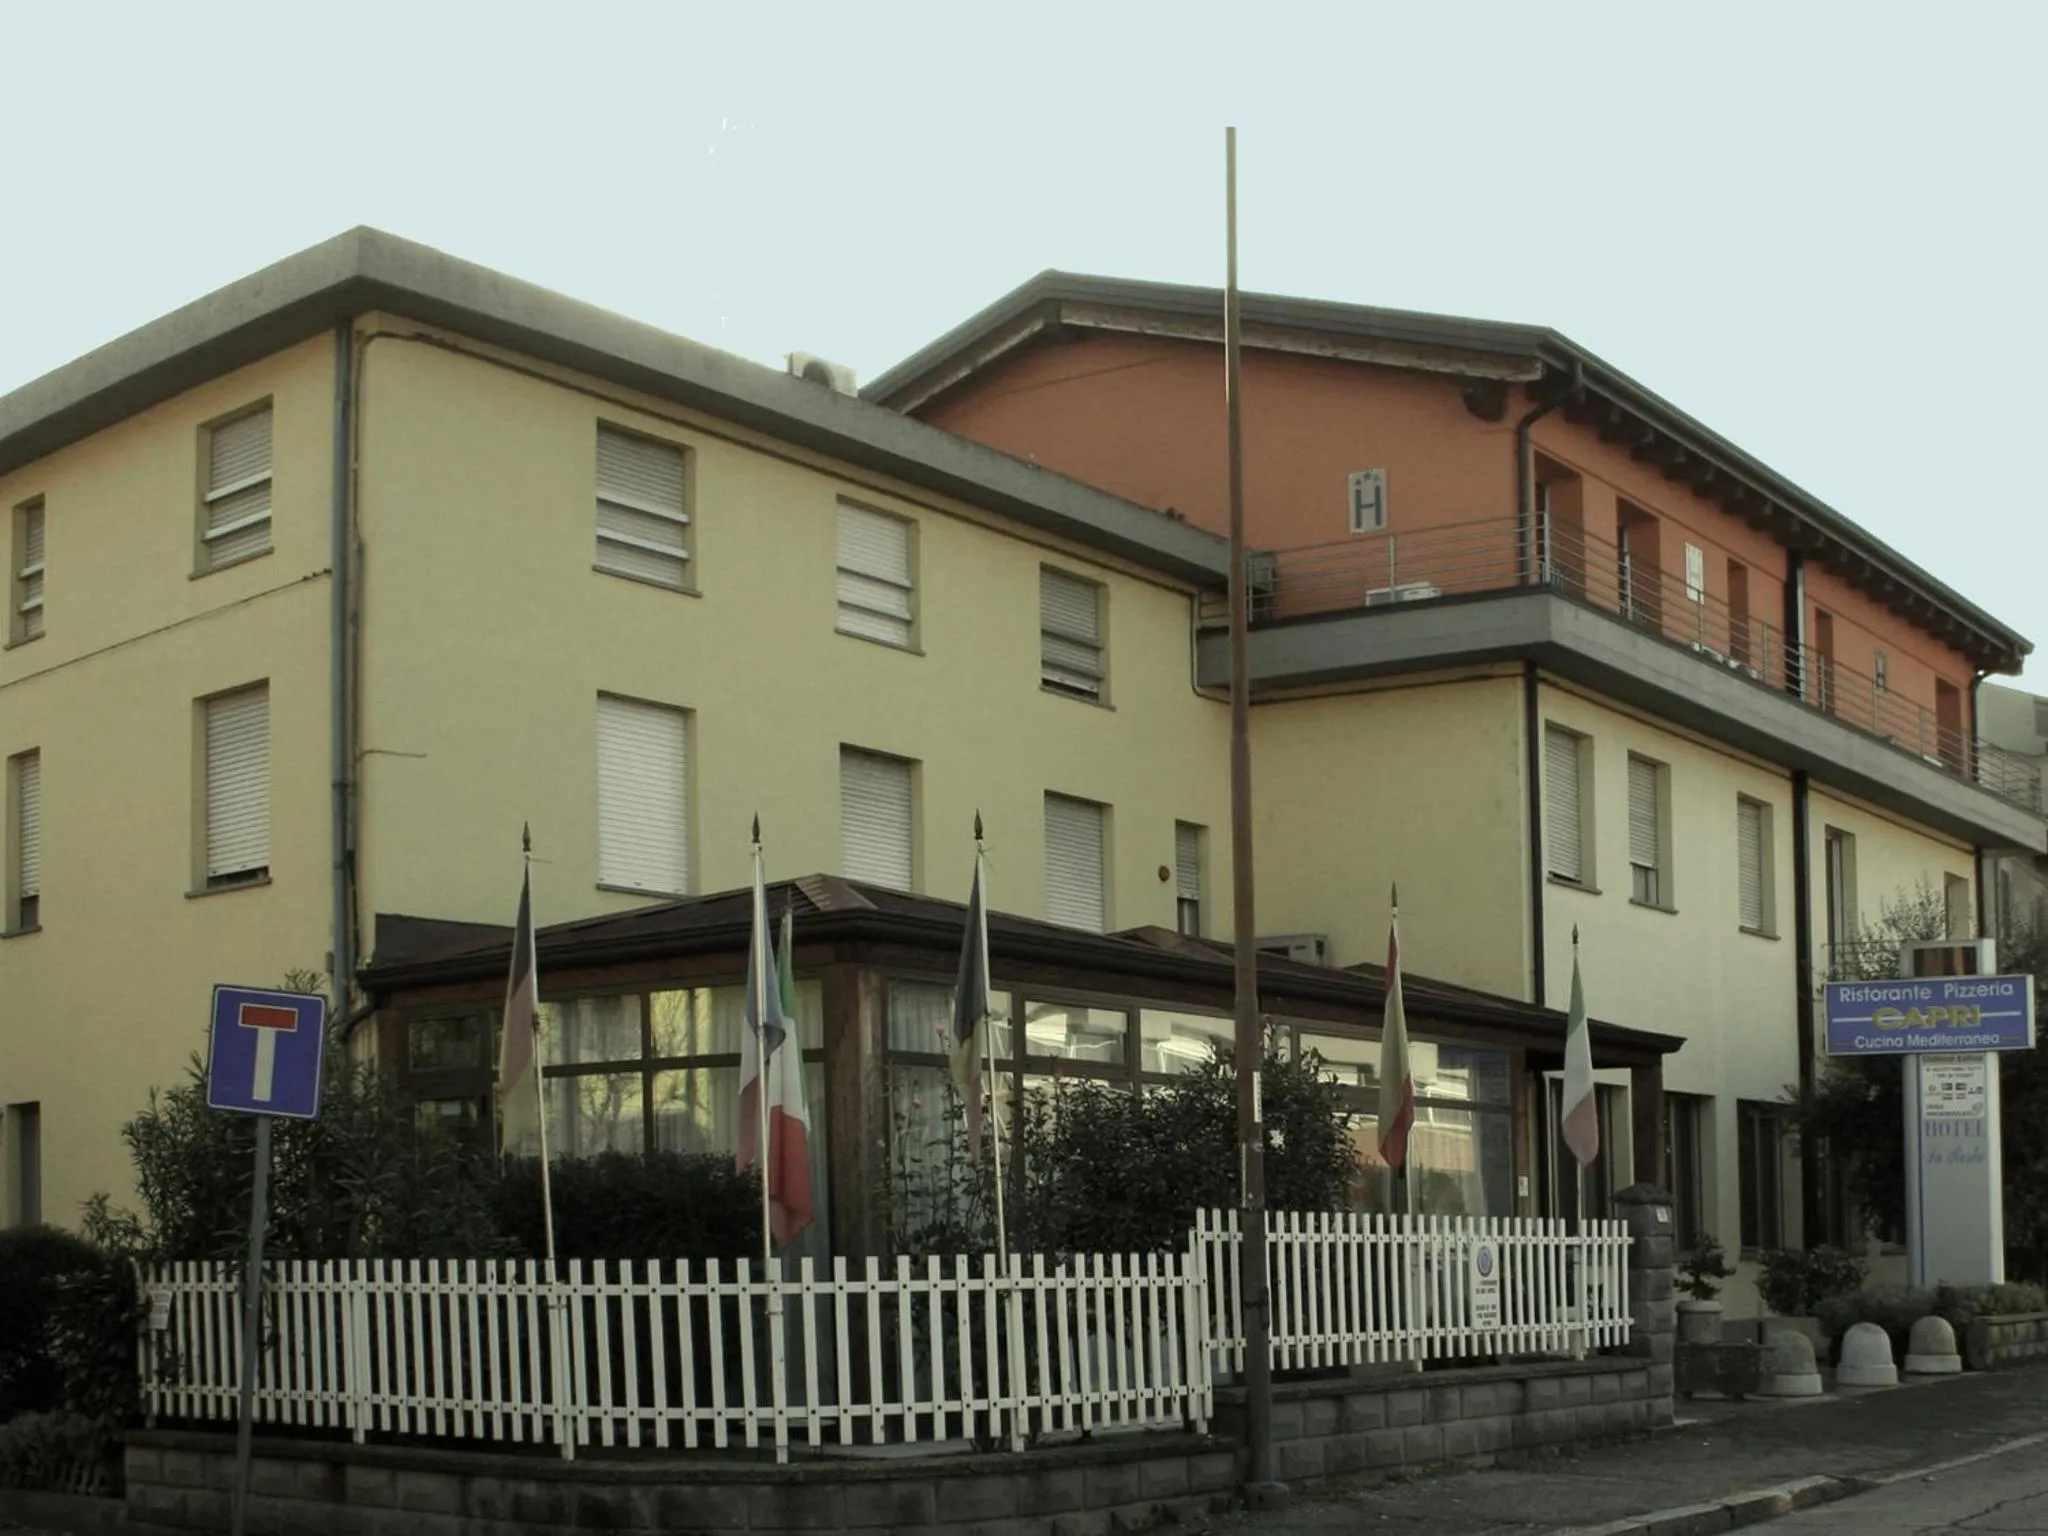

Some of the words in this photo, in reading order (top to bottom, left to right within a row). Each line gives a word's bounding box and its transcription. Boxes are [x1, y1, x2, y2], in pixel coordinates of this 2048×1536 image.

[1355, 485, 1382, 529] H
[1839, 985, 1932, 1003] Ristorante
[1944, 982, 2014, 999] Pizzeria
[1871, 1004, 1981, 1030] CAPRI
[1855, 1035, 1903, 1049] Cucina
[1908, 1033, 2000, 1048] Mediterranea
[1925, 1119, 1987, 1136] HOTEL
